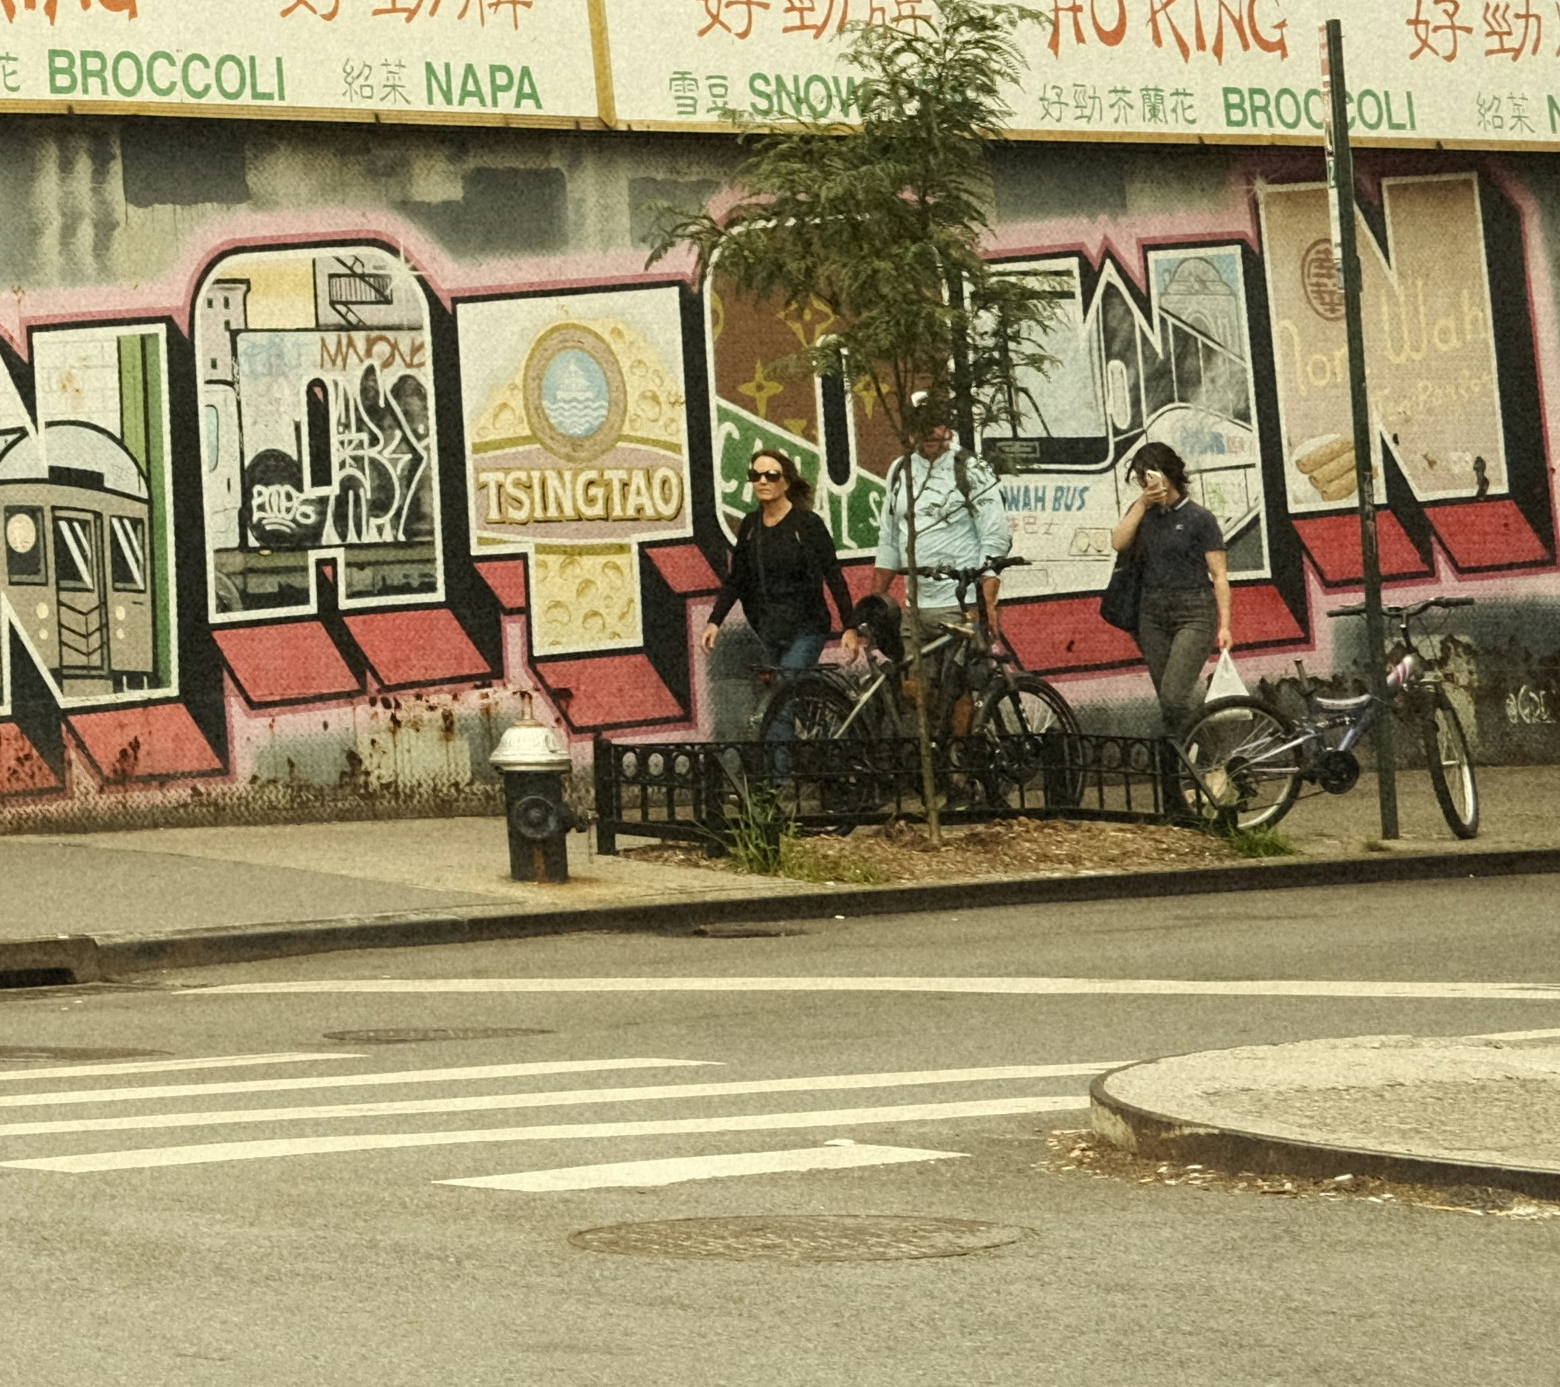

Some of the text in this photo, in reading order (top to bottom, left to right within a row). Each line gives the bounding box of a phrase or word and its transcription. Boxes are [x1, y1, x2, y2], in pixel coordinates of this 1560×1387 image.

[46, 48, 288, 105] BROCCOLI
[424, 59, 545, 113] NAPA
[484, 466, 683, 525] TSINGTAO
[1052, 484, 1090, 512] BUS
